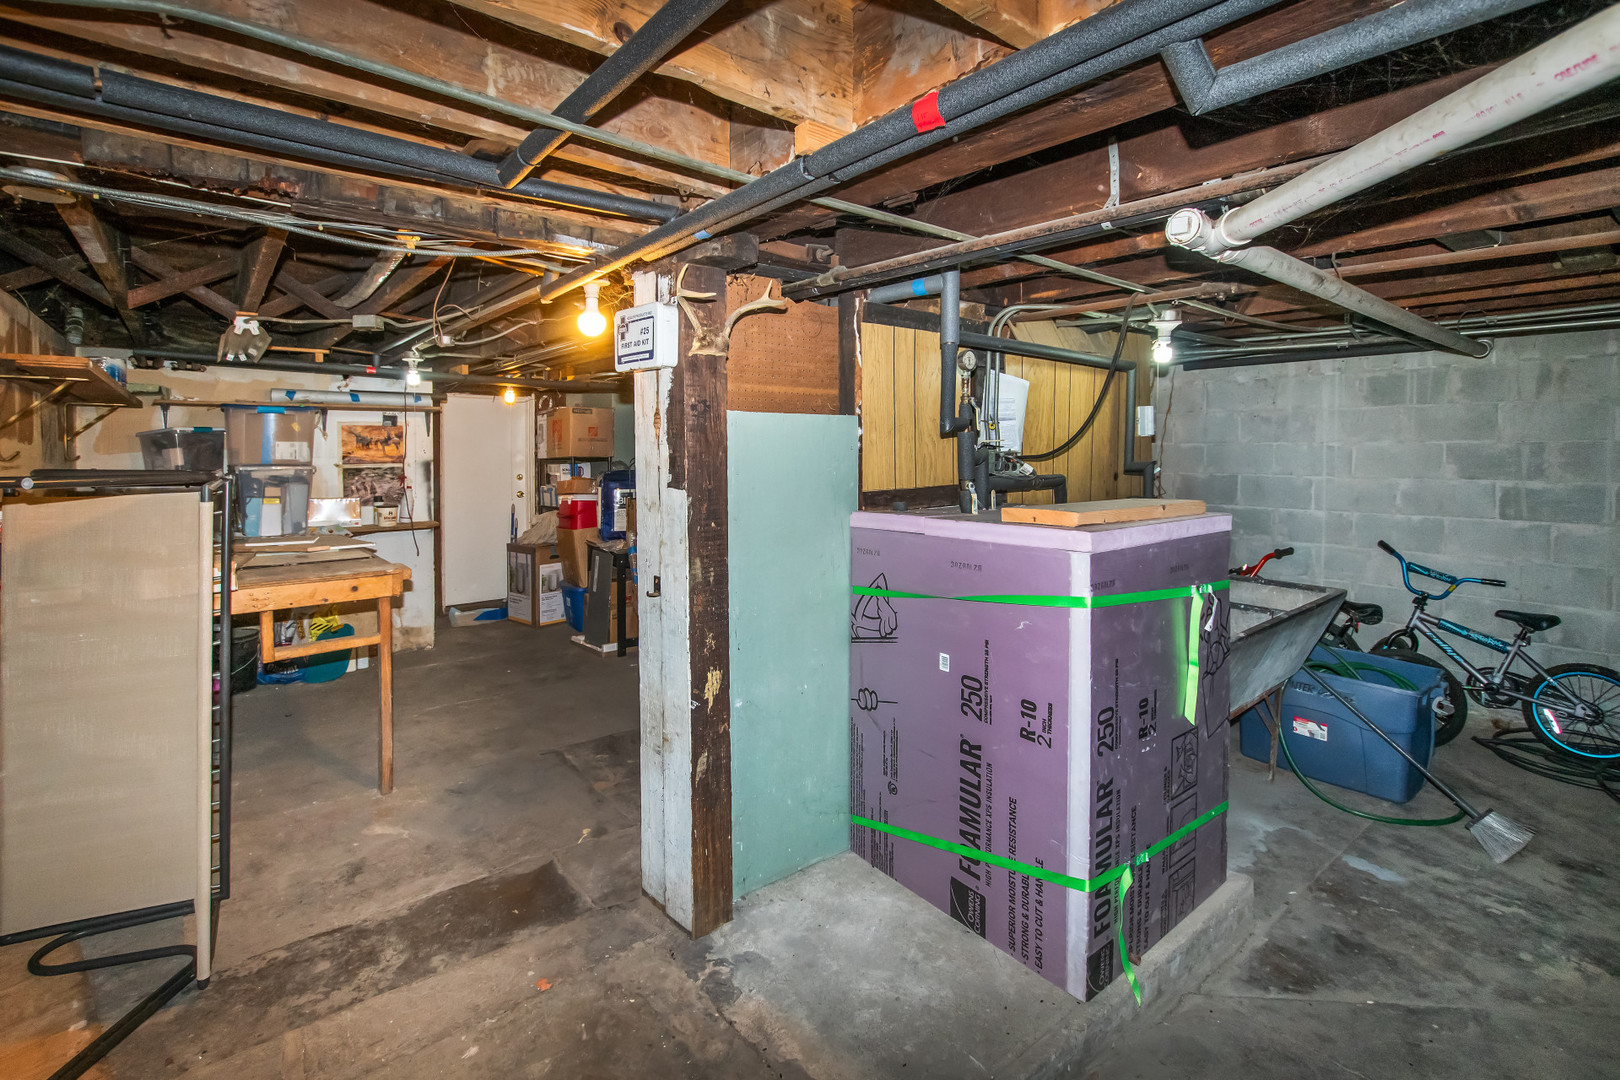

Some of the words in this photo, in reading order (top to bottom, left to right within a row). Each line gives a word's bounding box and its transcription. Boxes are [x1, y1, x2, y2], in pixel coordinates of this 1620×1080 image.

[621, 341, 632, 349] FIRST
[633, 340, 642, 348] AID
[642, 338, 650, 346] KIT
[640, 326, 650, 335] #25
[961, 674, 982, 722] 250
[1020, 698, 1037, 743] R-10
[1097, 706, 1114, 757] 250
[1139, 698, 1148, 740] R-10
[1036, 735, 1052, 749] 2
[1036, 857, 1044, 898] HANE
[1022, 874, 1030, 912] DURABL
[1036, 898, 1044, 907] &
[1008, 906, 1016, 952] SUPERIOR
[1022, 913, 1030, 921] &
[1035, 906, 1044, 928] CUT
[1035, 928, 1043, 943] TO
[1034, 944, 1042, 970] EASY
